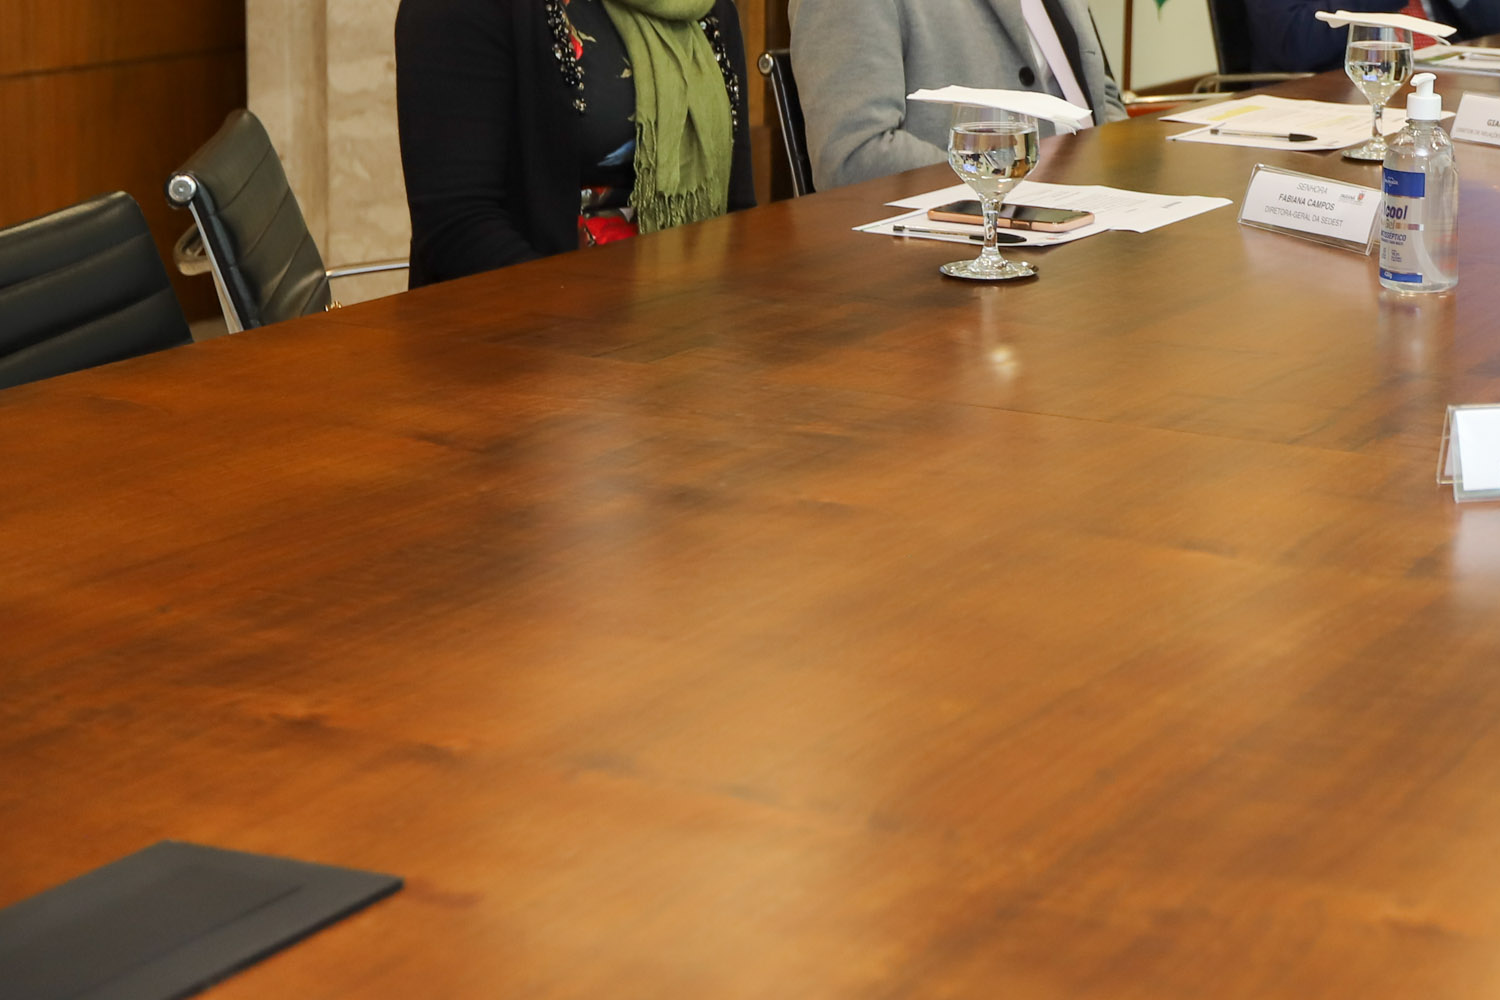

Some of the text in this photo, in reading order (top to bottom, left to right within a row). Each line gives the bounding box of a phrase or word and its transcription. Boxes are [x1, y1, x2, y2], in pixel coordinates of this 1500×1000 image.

[1296, 182, 1328, 194] SENHORA
[1278, 193, 1335, 211] FABIANA CAMPOS
